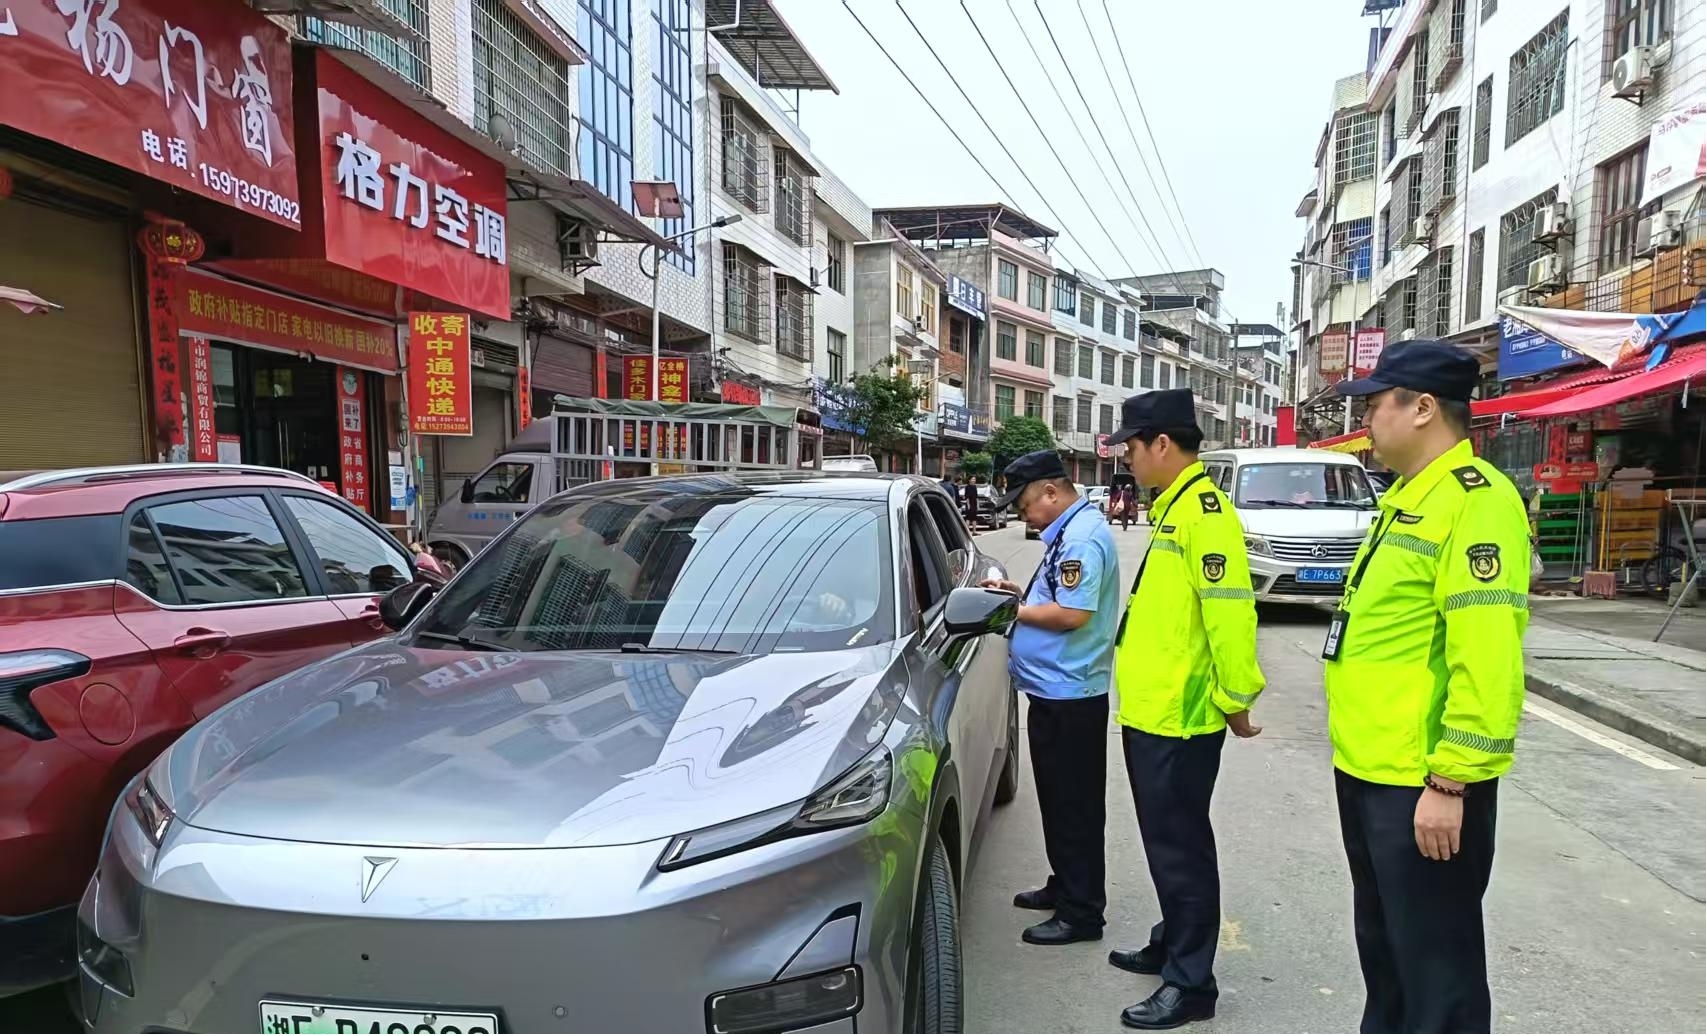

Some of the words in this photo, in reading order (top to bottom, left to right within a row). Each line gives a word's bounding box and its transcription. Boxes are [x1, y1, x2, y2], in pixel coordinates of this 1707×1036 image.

[0, 0, 272, 167] 杨门窗
[336, 131, 506, 265] 格力空调
[188, 288, 288, 336] 政府补贴指定门店
[414, 314, 465, 336] 收寄
[426, 336, 456, 416] 中通快递
